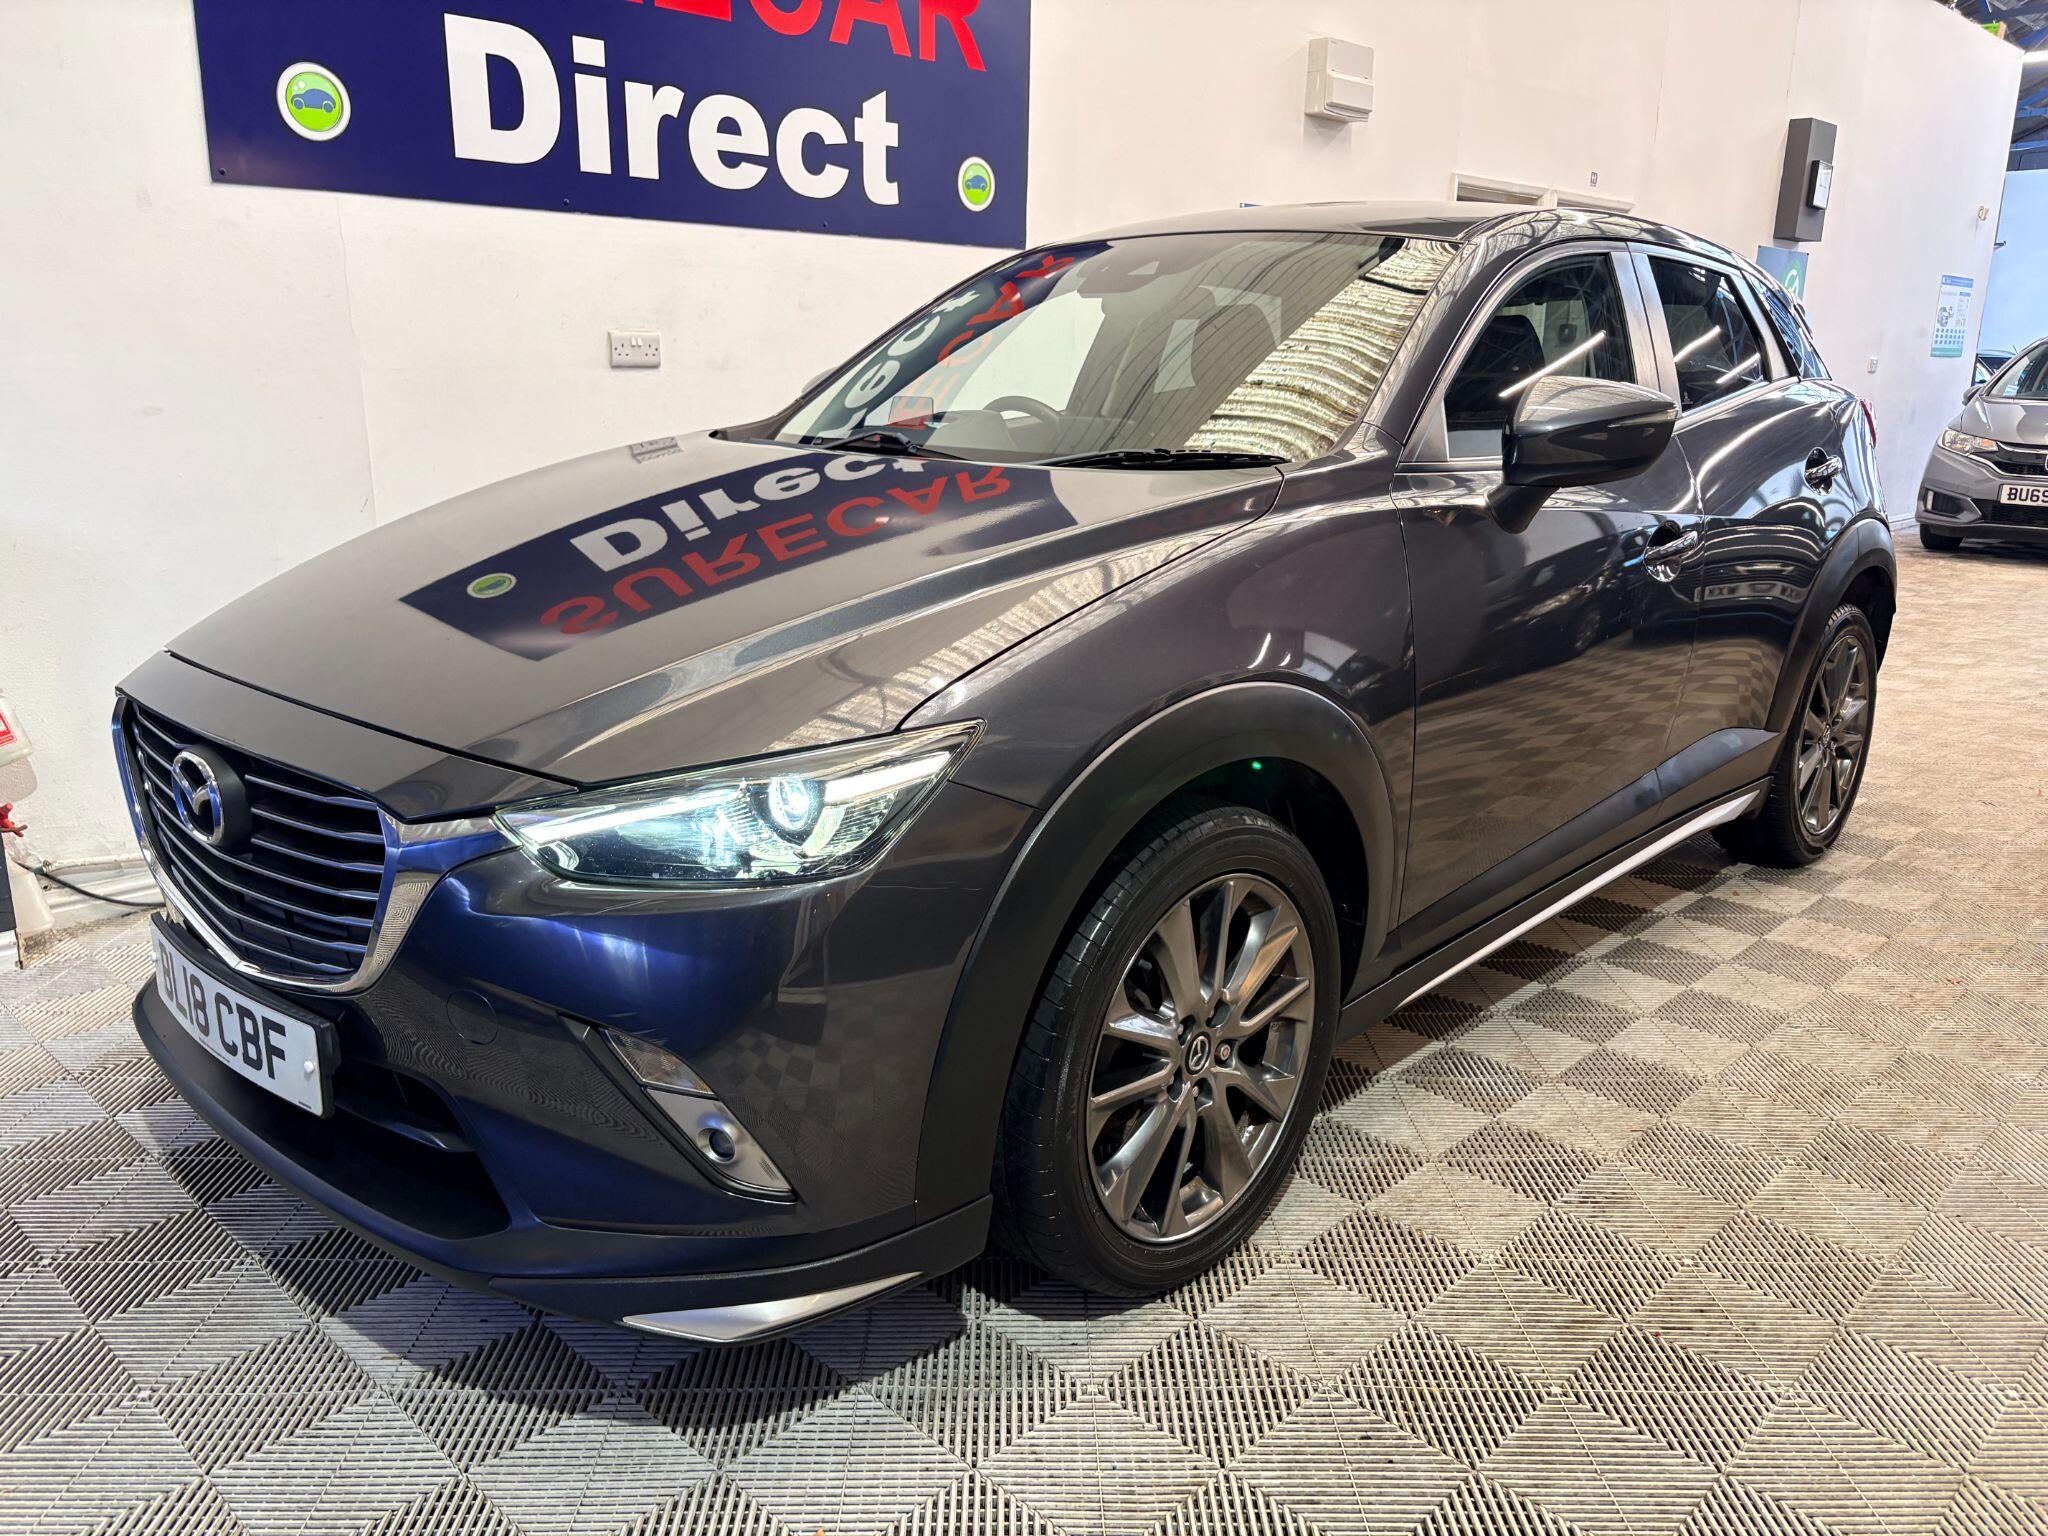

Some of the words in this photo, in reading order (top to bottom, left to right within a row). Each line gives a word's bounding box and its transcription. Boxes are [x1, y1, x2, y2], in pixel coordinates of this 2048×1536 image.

[444, 12, 899, 206] Direct
[159, 939, 210, 1038] BL18
[214, 991, 287, 1081] CBF
